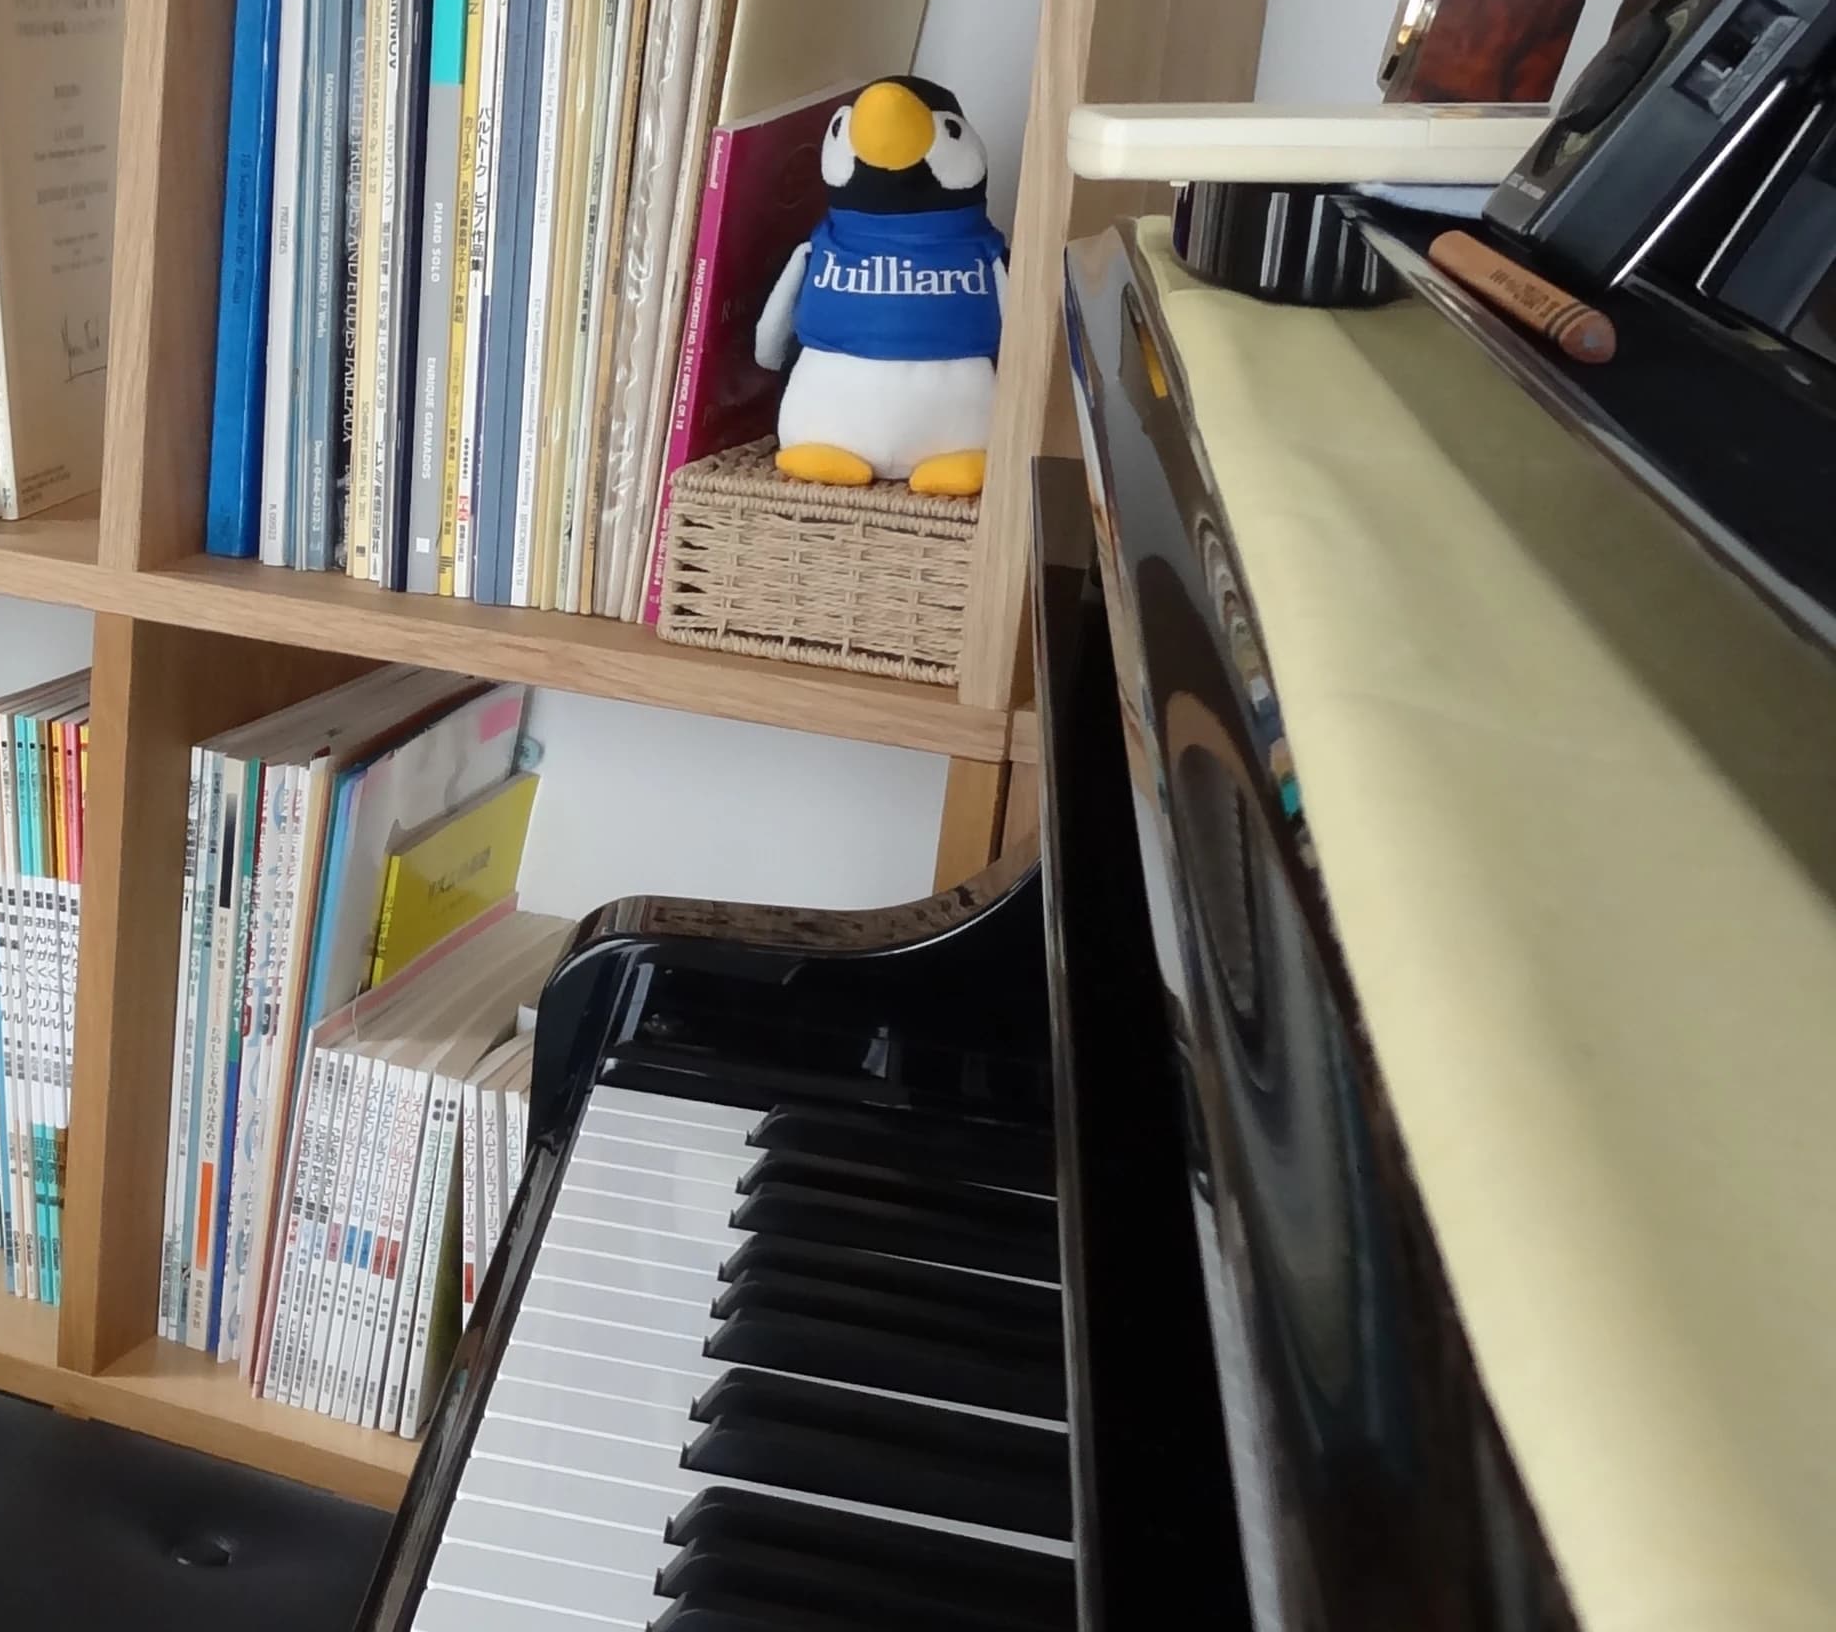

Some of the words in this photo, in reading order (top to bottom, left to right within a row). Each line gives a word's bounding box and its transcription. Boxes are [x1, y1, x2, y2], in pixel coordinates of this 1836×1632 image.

[320, 72, 337, 148] RACHMANINOFF
[475, 107, 491, 177] バルトーク
[318, 149, 334, 212] MASTERPIECES
[275, 206, 291, 255] PRELUDES
[317, 235, 330, 260] SOLO
[432, 202, 443, 243] PIANO
[471, 193, 487, 272] ピアノ作品集
[315, 262, 329, 295] PIANO:
[431, 248, 441, 283] SOLO
[694, 258, 707, 284] PIANO
[814, 251, 988, 296] Juilliard
[314, 310, 327, 338] Works
[687, 285, 703, 329] CONCERTO
[425, 357, 436, 409] ENRIQUE
[422, 413, 435, 480] GRANADOS
[23, 916, 37, 1026] おんがくドリル
[36, 917, 52, 1029] おんがくドリル
[47, 918, 60, 1030] おんがくドリル
[339, 1074, 365, 1198] リズムとソルフェージュ
[356, 1078, 381, 1202] リズムとソルフェージュ
[370, 1081, 397, 1206] リズムとソルフェージュ
[383, 1087, 410, 1212] リズムとソルフェージュ
[397, 1092, 423, 1216] リズムとソルフェージュ
[464, 1107, 476, 1236] リズムとソルフェージュ
[506, 1113, 521, 1203] リズムとソル
[483, 1110, 499, 1242] リズムとソルフェージュ
